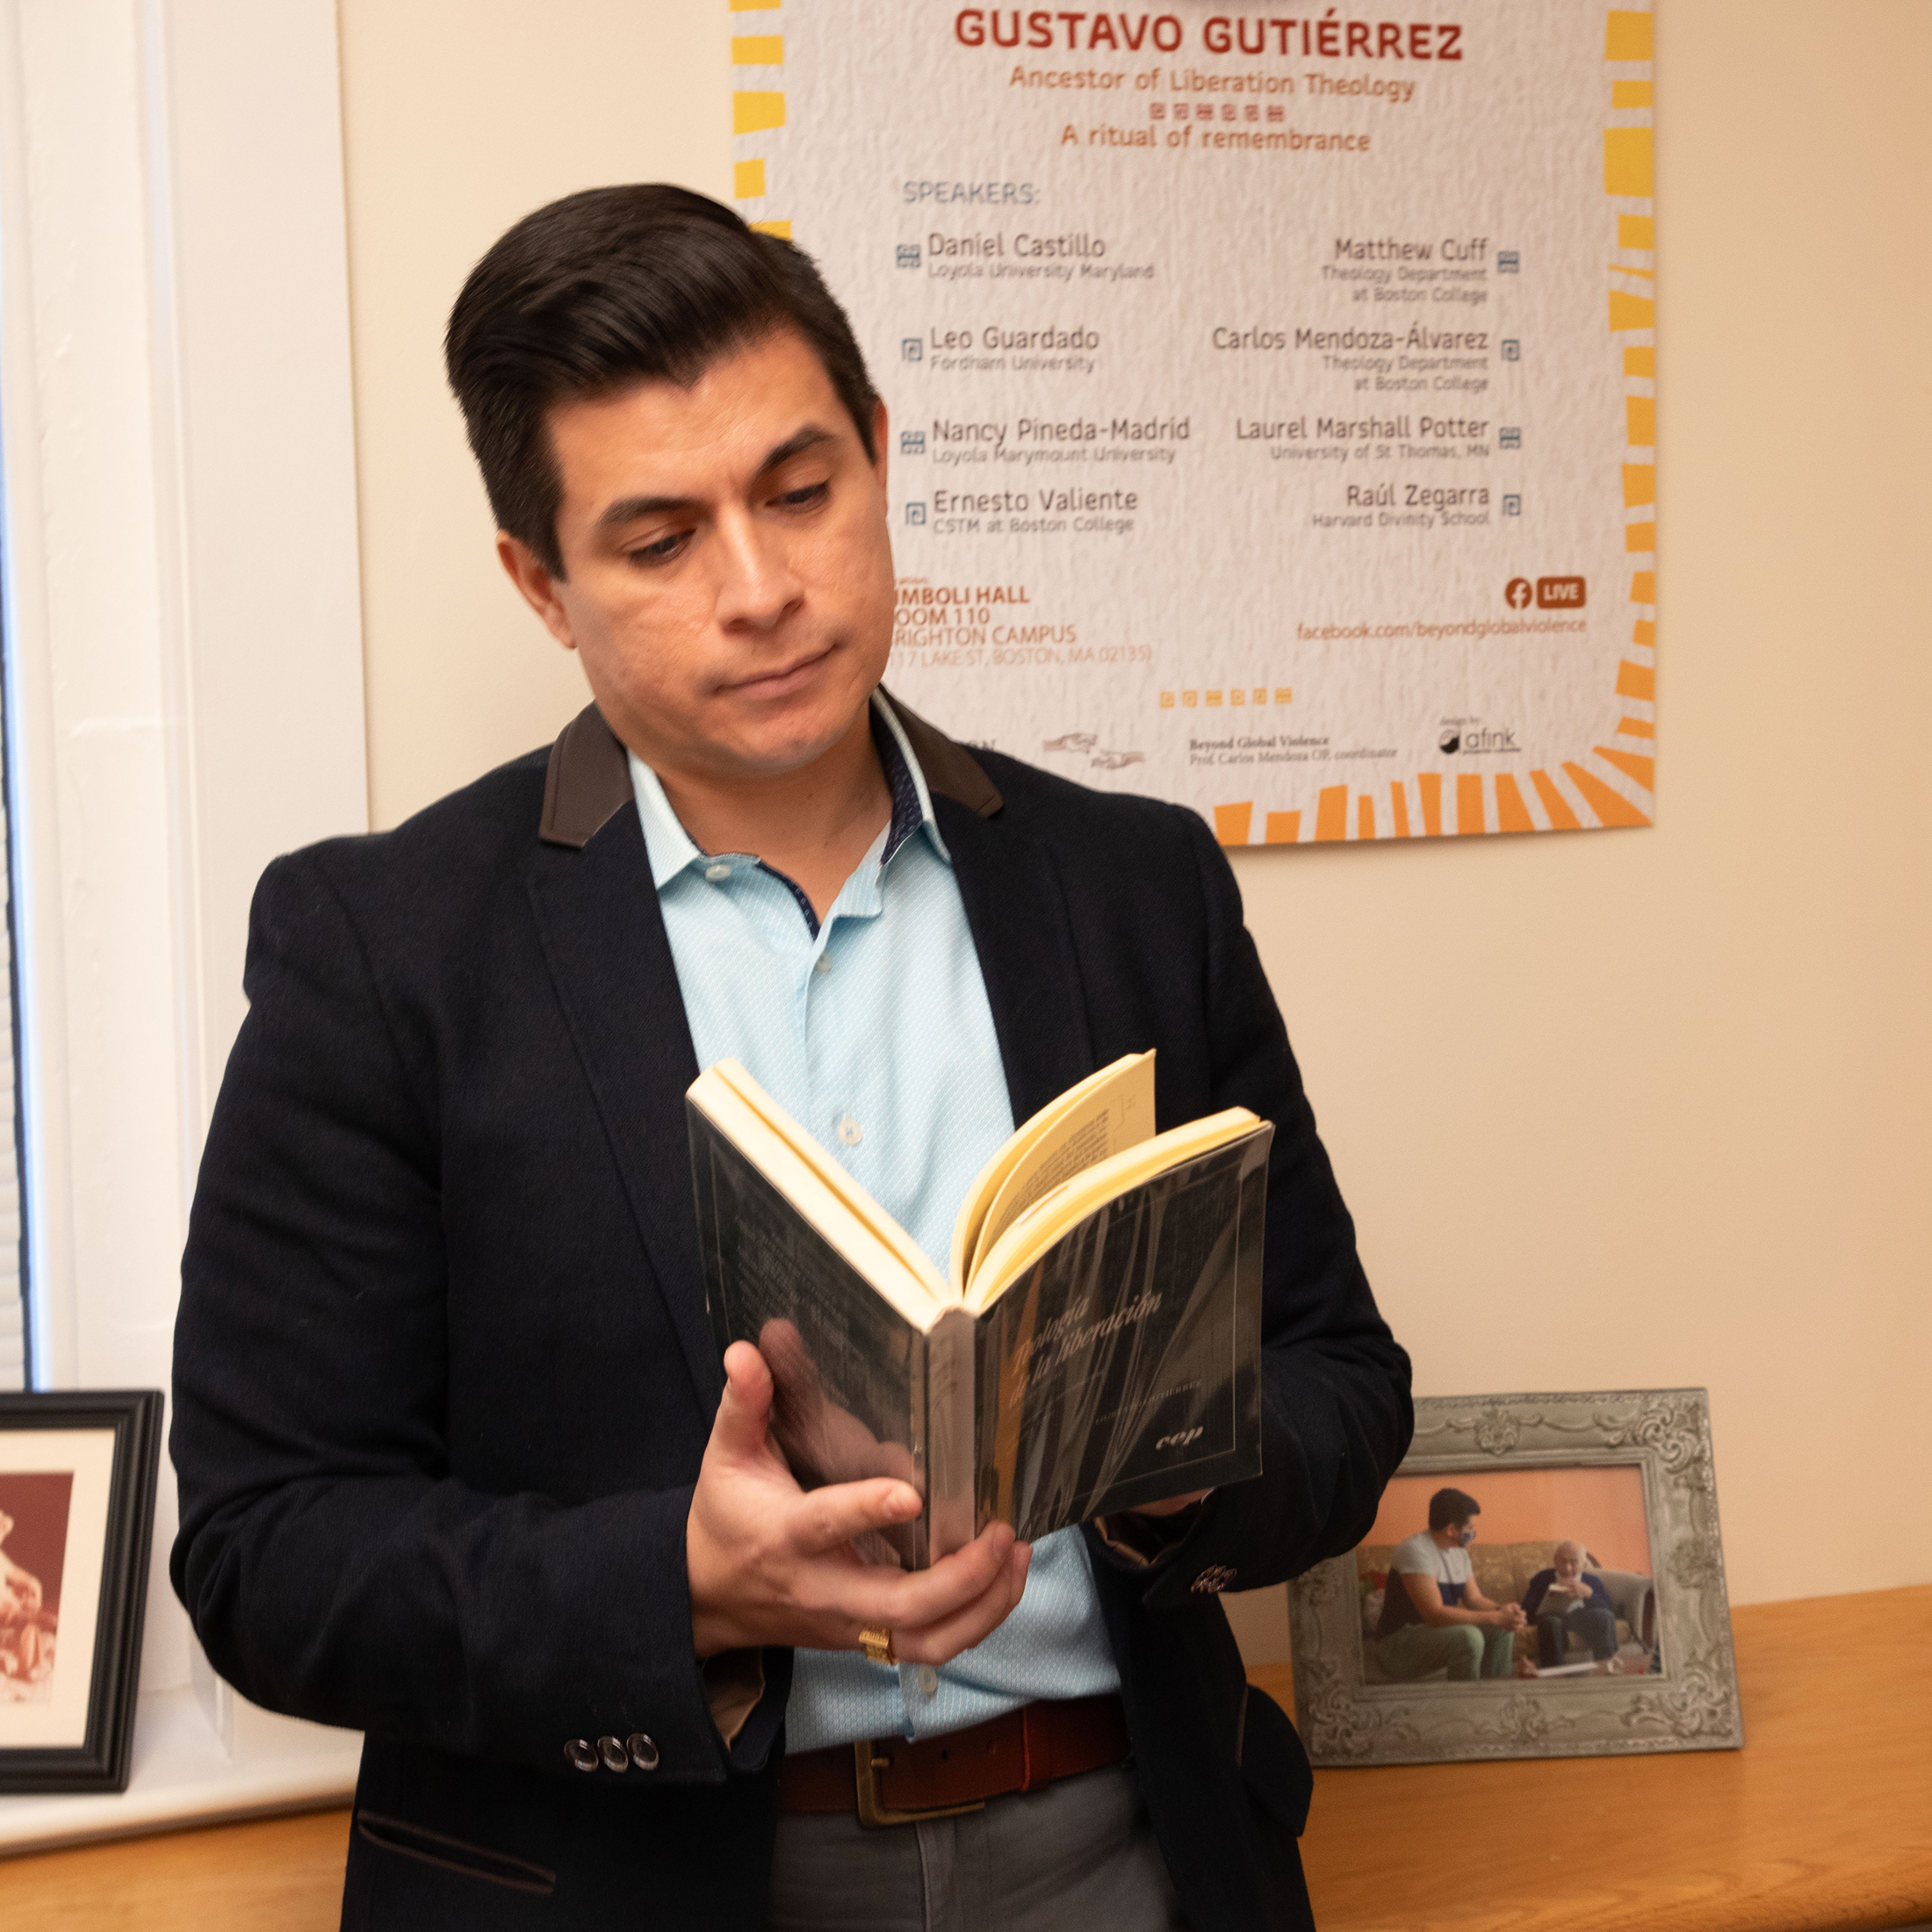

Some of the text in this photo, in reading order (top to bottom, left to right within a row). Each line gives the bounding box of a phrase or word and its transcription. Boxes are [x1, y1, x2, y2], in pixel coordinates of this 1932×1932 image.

[955, 8, 1463, 61] GUSTAVO GUTIÉRREZ
[1009, 66, 1416, 103] Ancestor of Liberation Theology
[1061, 125, 1370, 152] A ritual of remembrance
[903, 181, 1041, 205] SPEAKERS:
[928, 233, 1106, 257] Daniel Castillo
[1335, 237, 1489, 262] Matthew Cuff
[929, 263, 1154, 282] Loyola University Maryland
[1322, 265, 1488, 283] Theology Department
[1352, 287, 1488, 306] at Boston College
[930, 326, 1099, 350] Leo Guardado
[1212, 321, 1489, 350] Carlos Mendoza-Álvarez
[930, 355, 1095, 373] Fordham University
[1323, 356, 1488, 373] Theology Department
[1354, 376, 1489, 394] at Boston College
[933, 416, 1191, 446] Nancy Pineda-Madrid
[1236, 415, 1490, 440] Laurel Marshall Potter
[933, 445, 1176, 465] Loyola Marymount University
[1271, 444, 1348, 462] University
[1354, 443, 1371, 459] of
[934, 487, 1138, 513] Ernesto Valiente
[1347, 483, 1489, 511] Raúl Zegarra
[934, 515, 1135, 535] CSTM at Boston College
[1313, 511, 1490, 530] Harvard Divinity School
[895, 586, 1029, 605] IMBOLI HALL
[1544, 584, 1580, 601] LIVE
[895, 608, 991, 626] OOM 110
[894, 624, 1076, 647] RIGHTON CAMPUS
[1297, 619, 1586, 641] facebook.com/beyondglobalviolence
[922, 649, 959, 667] LAKE
[993, 646, 1065, 667] BOSTON,
[1068, 646, 1095, 663] MA
[1190, 734, 1330, 752] Beyond Global Violence
[1219, 752, 1254, 764] Carlos
[1258, 749, 1308, 762] Mendoza
[1335, 746, 1398, 759] coordinator
[1032, 1354, 1051, 1385] la
[1056, 1290, 1163, 1366] liberación
[1155, 1424, 1204, 1451] cep
